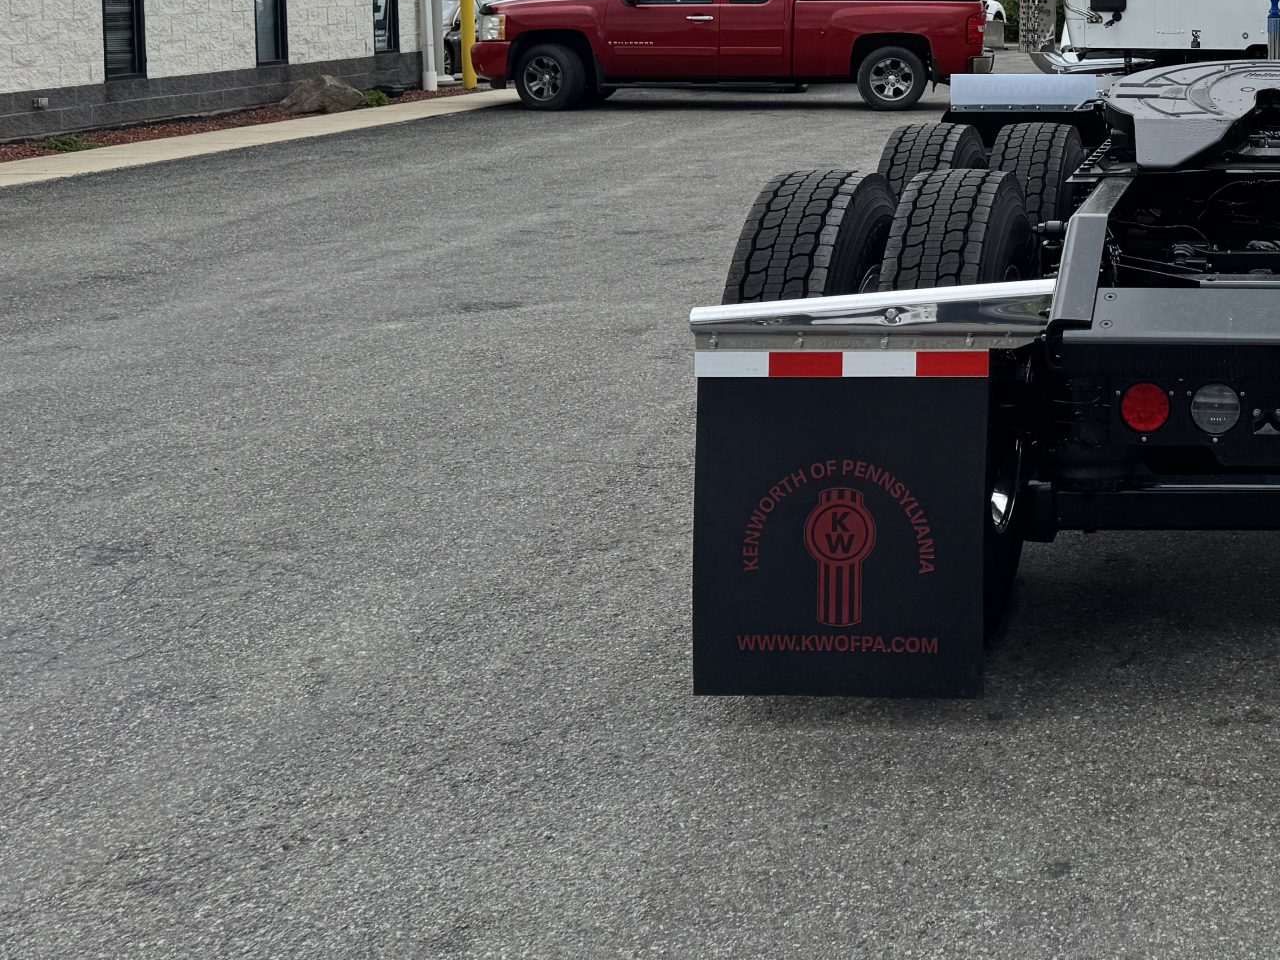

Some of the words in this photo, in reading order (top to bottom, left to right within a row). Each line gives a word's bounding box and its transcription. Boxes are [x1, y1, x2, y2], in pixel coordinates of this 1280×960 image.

[742, 469, 808, 572] KENWORTH
[810, 459, 837, 480] OF
[842, 459, 936, 575] PENNSYLVANIA
[736, 634, 939, 654] WWW.KWOFPA.COM
